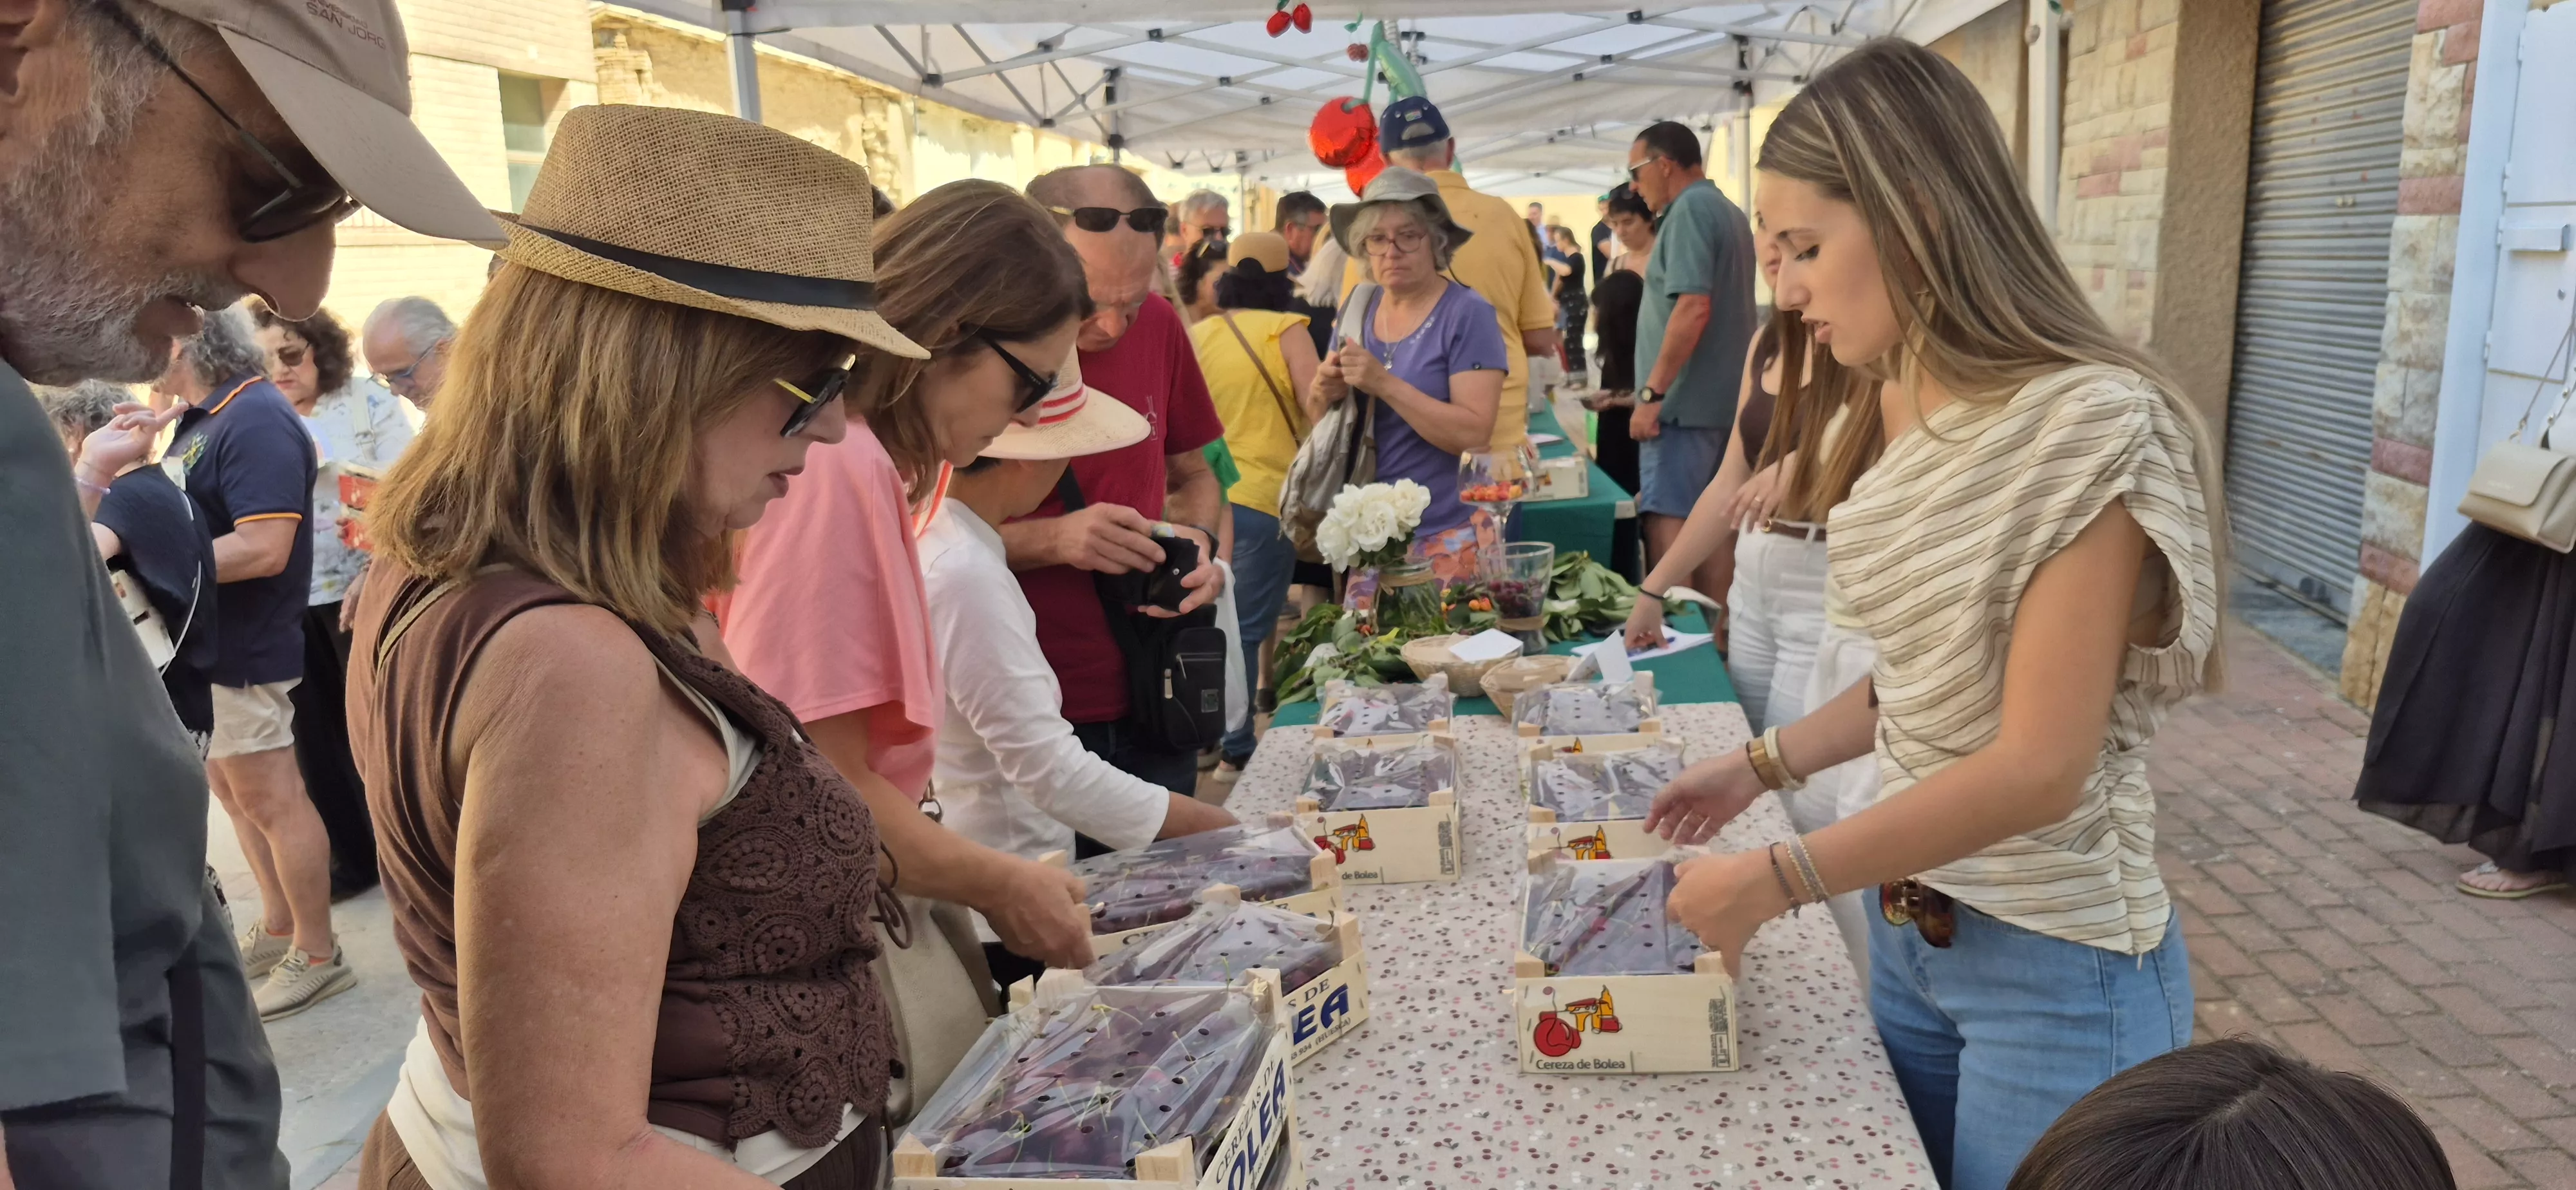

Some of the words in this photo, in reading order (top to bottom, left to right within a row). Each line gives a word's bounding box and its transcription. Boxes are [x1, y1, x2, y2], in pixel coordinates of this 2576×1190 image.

[306, 1, 343, 28] SAN
[348, 24, 386, 50] JORG
[1341, 871, 1352, 880] de
[1354, 870, 1378, 880] Bolea
[1293, 983, 1349, 1046] EA
[1305, 978, 1330, 1003] DE
[1536, 1059, 1574, 1070] Cereza
[1577, 1059, 1591, 1069] de
[1593, 1058, 1625, 1069] Bolea
[1216, 1086, 1262, 1184] CEREZAS
[1227, 1057, 1285, 1190] OLEA
